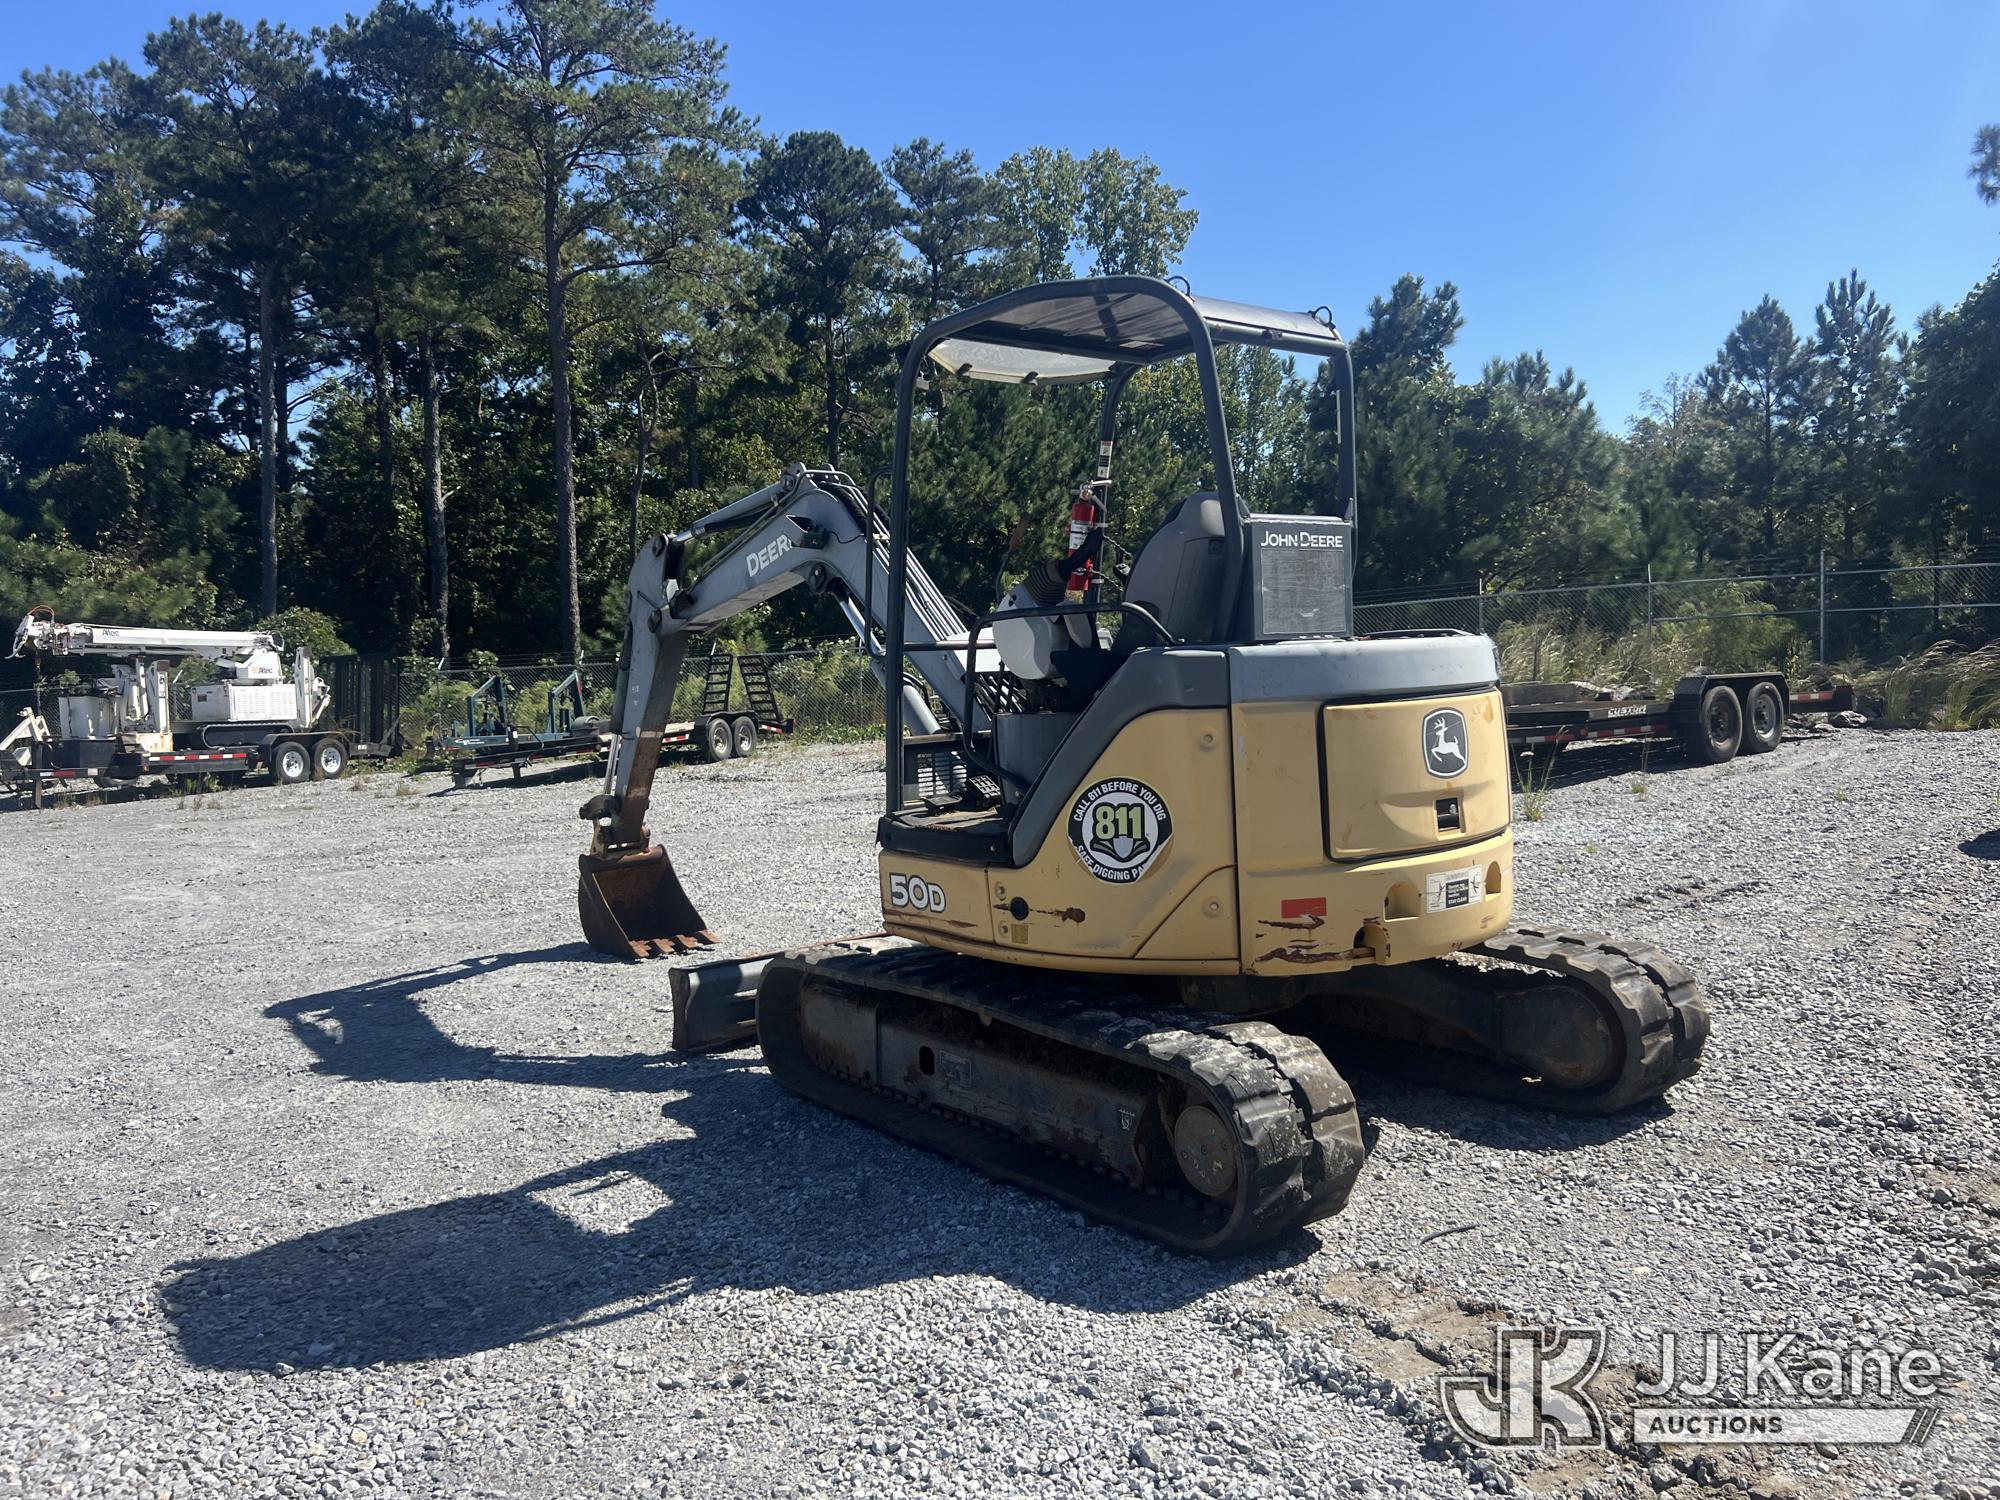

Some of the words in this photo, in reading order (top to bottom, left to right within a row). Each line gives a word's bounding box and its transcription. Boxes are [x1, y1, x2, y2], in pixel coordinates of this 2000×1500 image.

[1261, 531, 1298, 547] JOHN
[1300, 532, 1344, 548] DEERE
[102, 628, 120, 637] Altec
[1607, 704, 1647, 716] CUSTOM
[1073, 799, 1091, 822] CALL
[1087, 787, 1102, 801] 811
[1101, 781, 1139, 794] BEFORE
[1138, 787, 1157, 805] YOU
[1152, 803, 1167, 821] DIG
[1095, 805, 1142, 840] 811
[1093, 864, 1130, 880] DIGGING
[1131, 866, 1145, 879] PA
[889, 872, 946, 913] 50D
